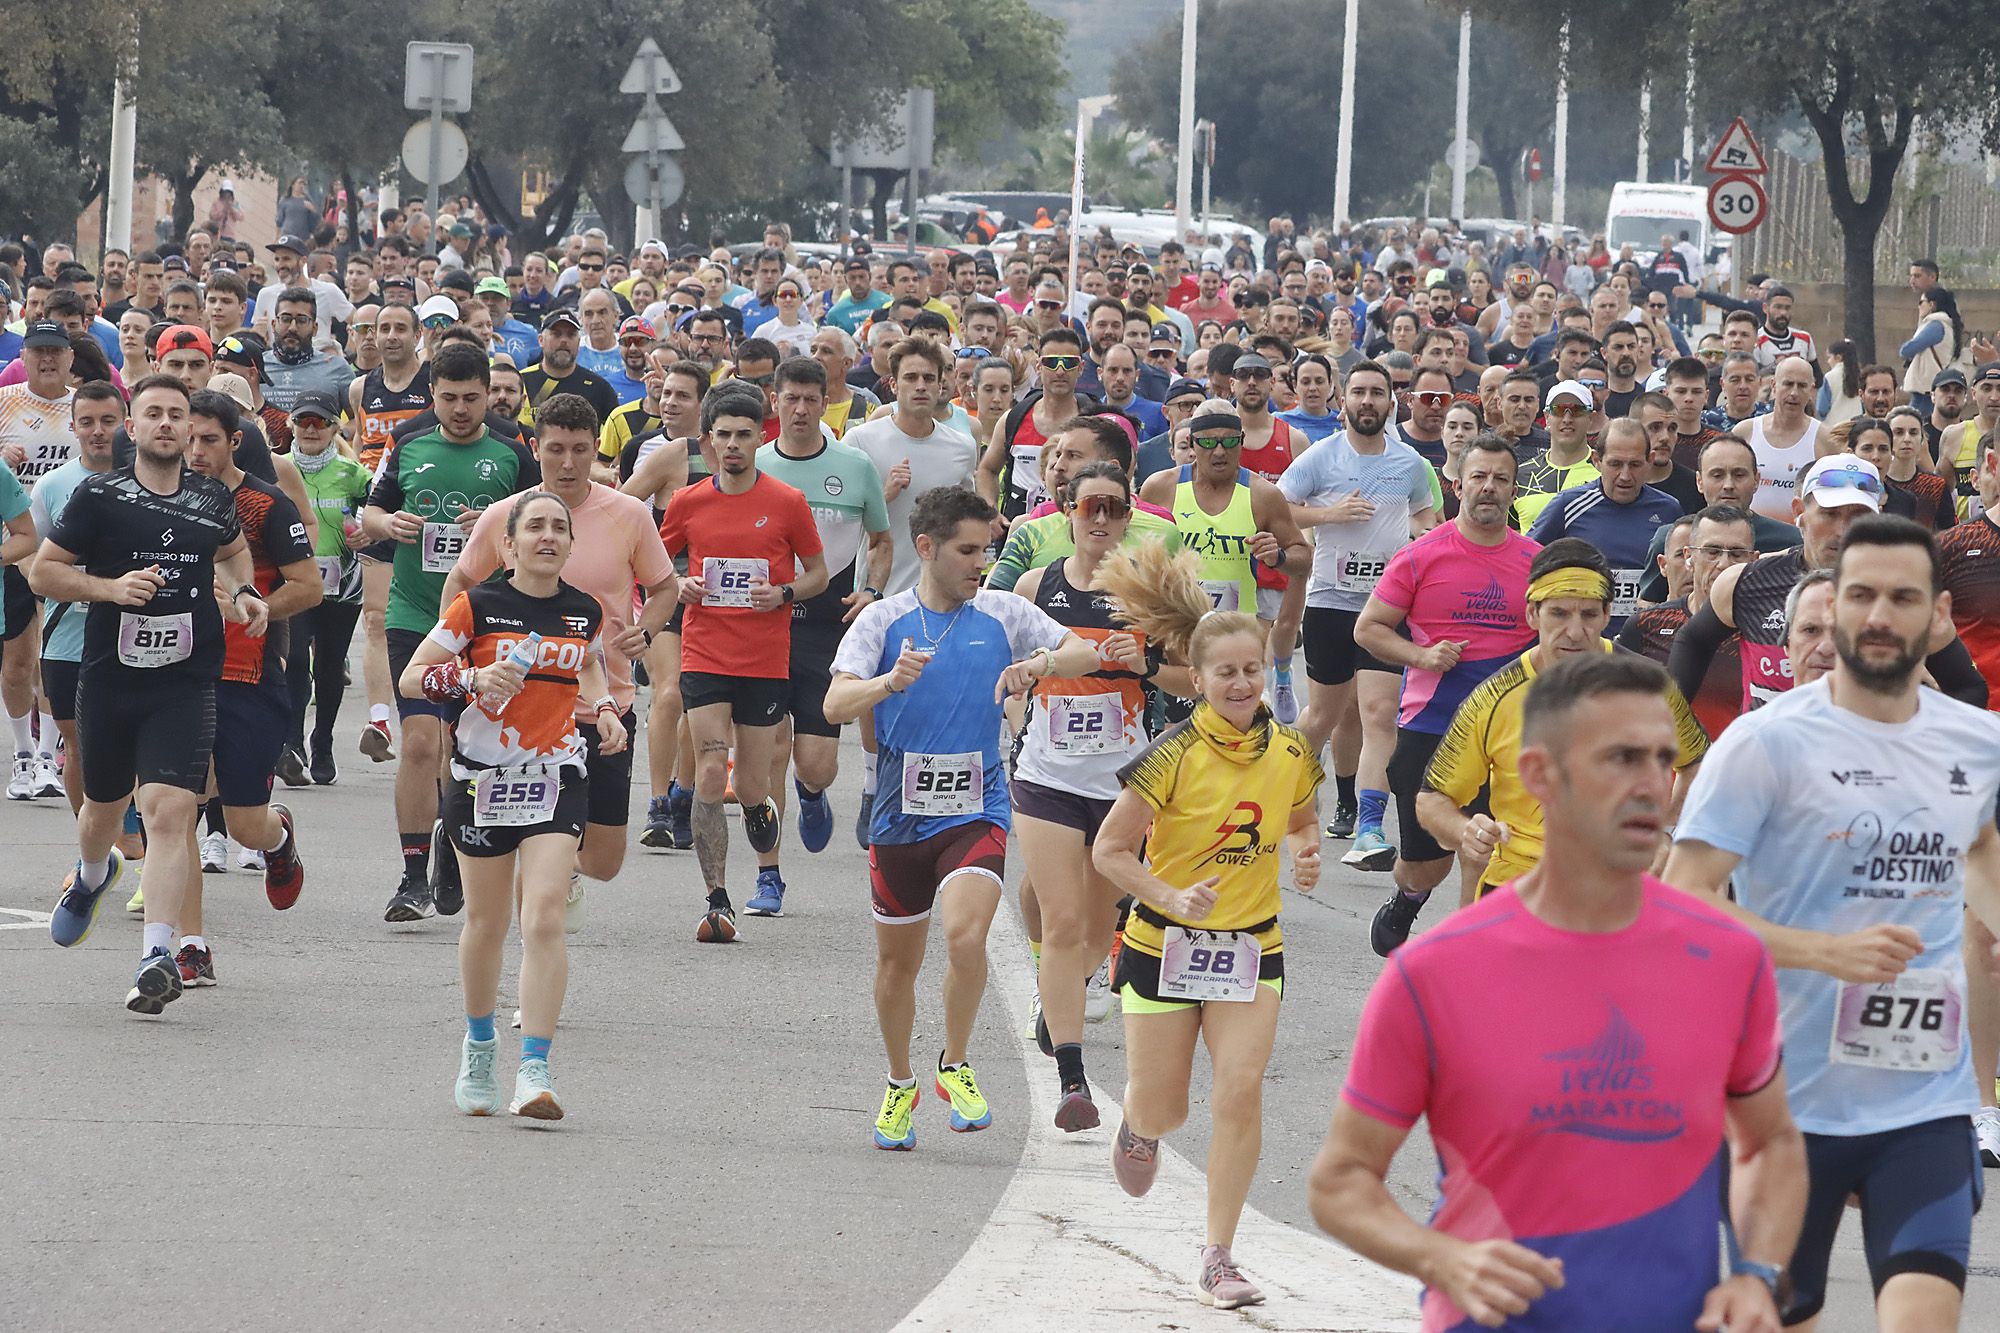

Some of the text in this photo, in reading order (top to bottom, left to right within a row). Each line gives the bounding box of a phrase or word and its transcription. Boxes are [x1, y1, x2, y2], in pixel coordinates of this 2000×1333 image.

[1720, 194, 1755, 214] 30
[36, 445, 71, 460] 21K
[433, 537, 470, 553] 63
[132, 551, 199, 562] 2 FEBRERO 2025
[1344, 561, 1385, 577] 822
[720, 571, 751, 588] 62
[1452, 611, 1517, 623] MARATON
[134, 630, 179, 648] 812
[1067, 712, 1103, 732] 22
[915, 770, 972, 792] 922
[489, 782, 546, 803] 259
[459, 825, 492, 847] 15K
[1869, 856, 1955, 884] DESTINO
[1188, 949, 1235, 974] 98
[1203, 975, 1241, 984] CARMEN
[1860, 995, 1945, 1031] 876
[1529, 1100, 1684, 1122] MARATON
